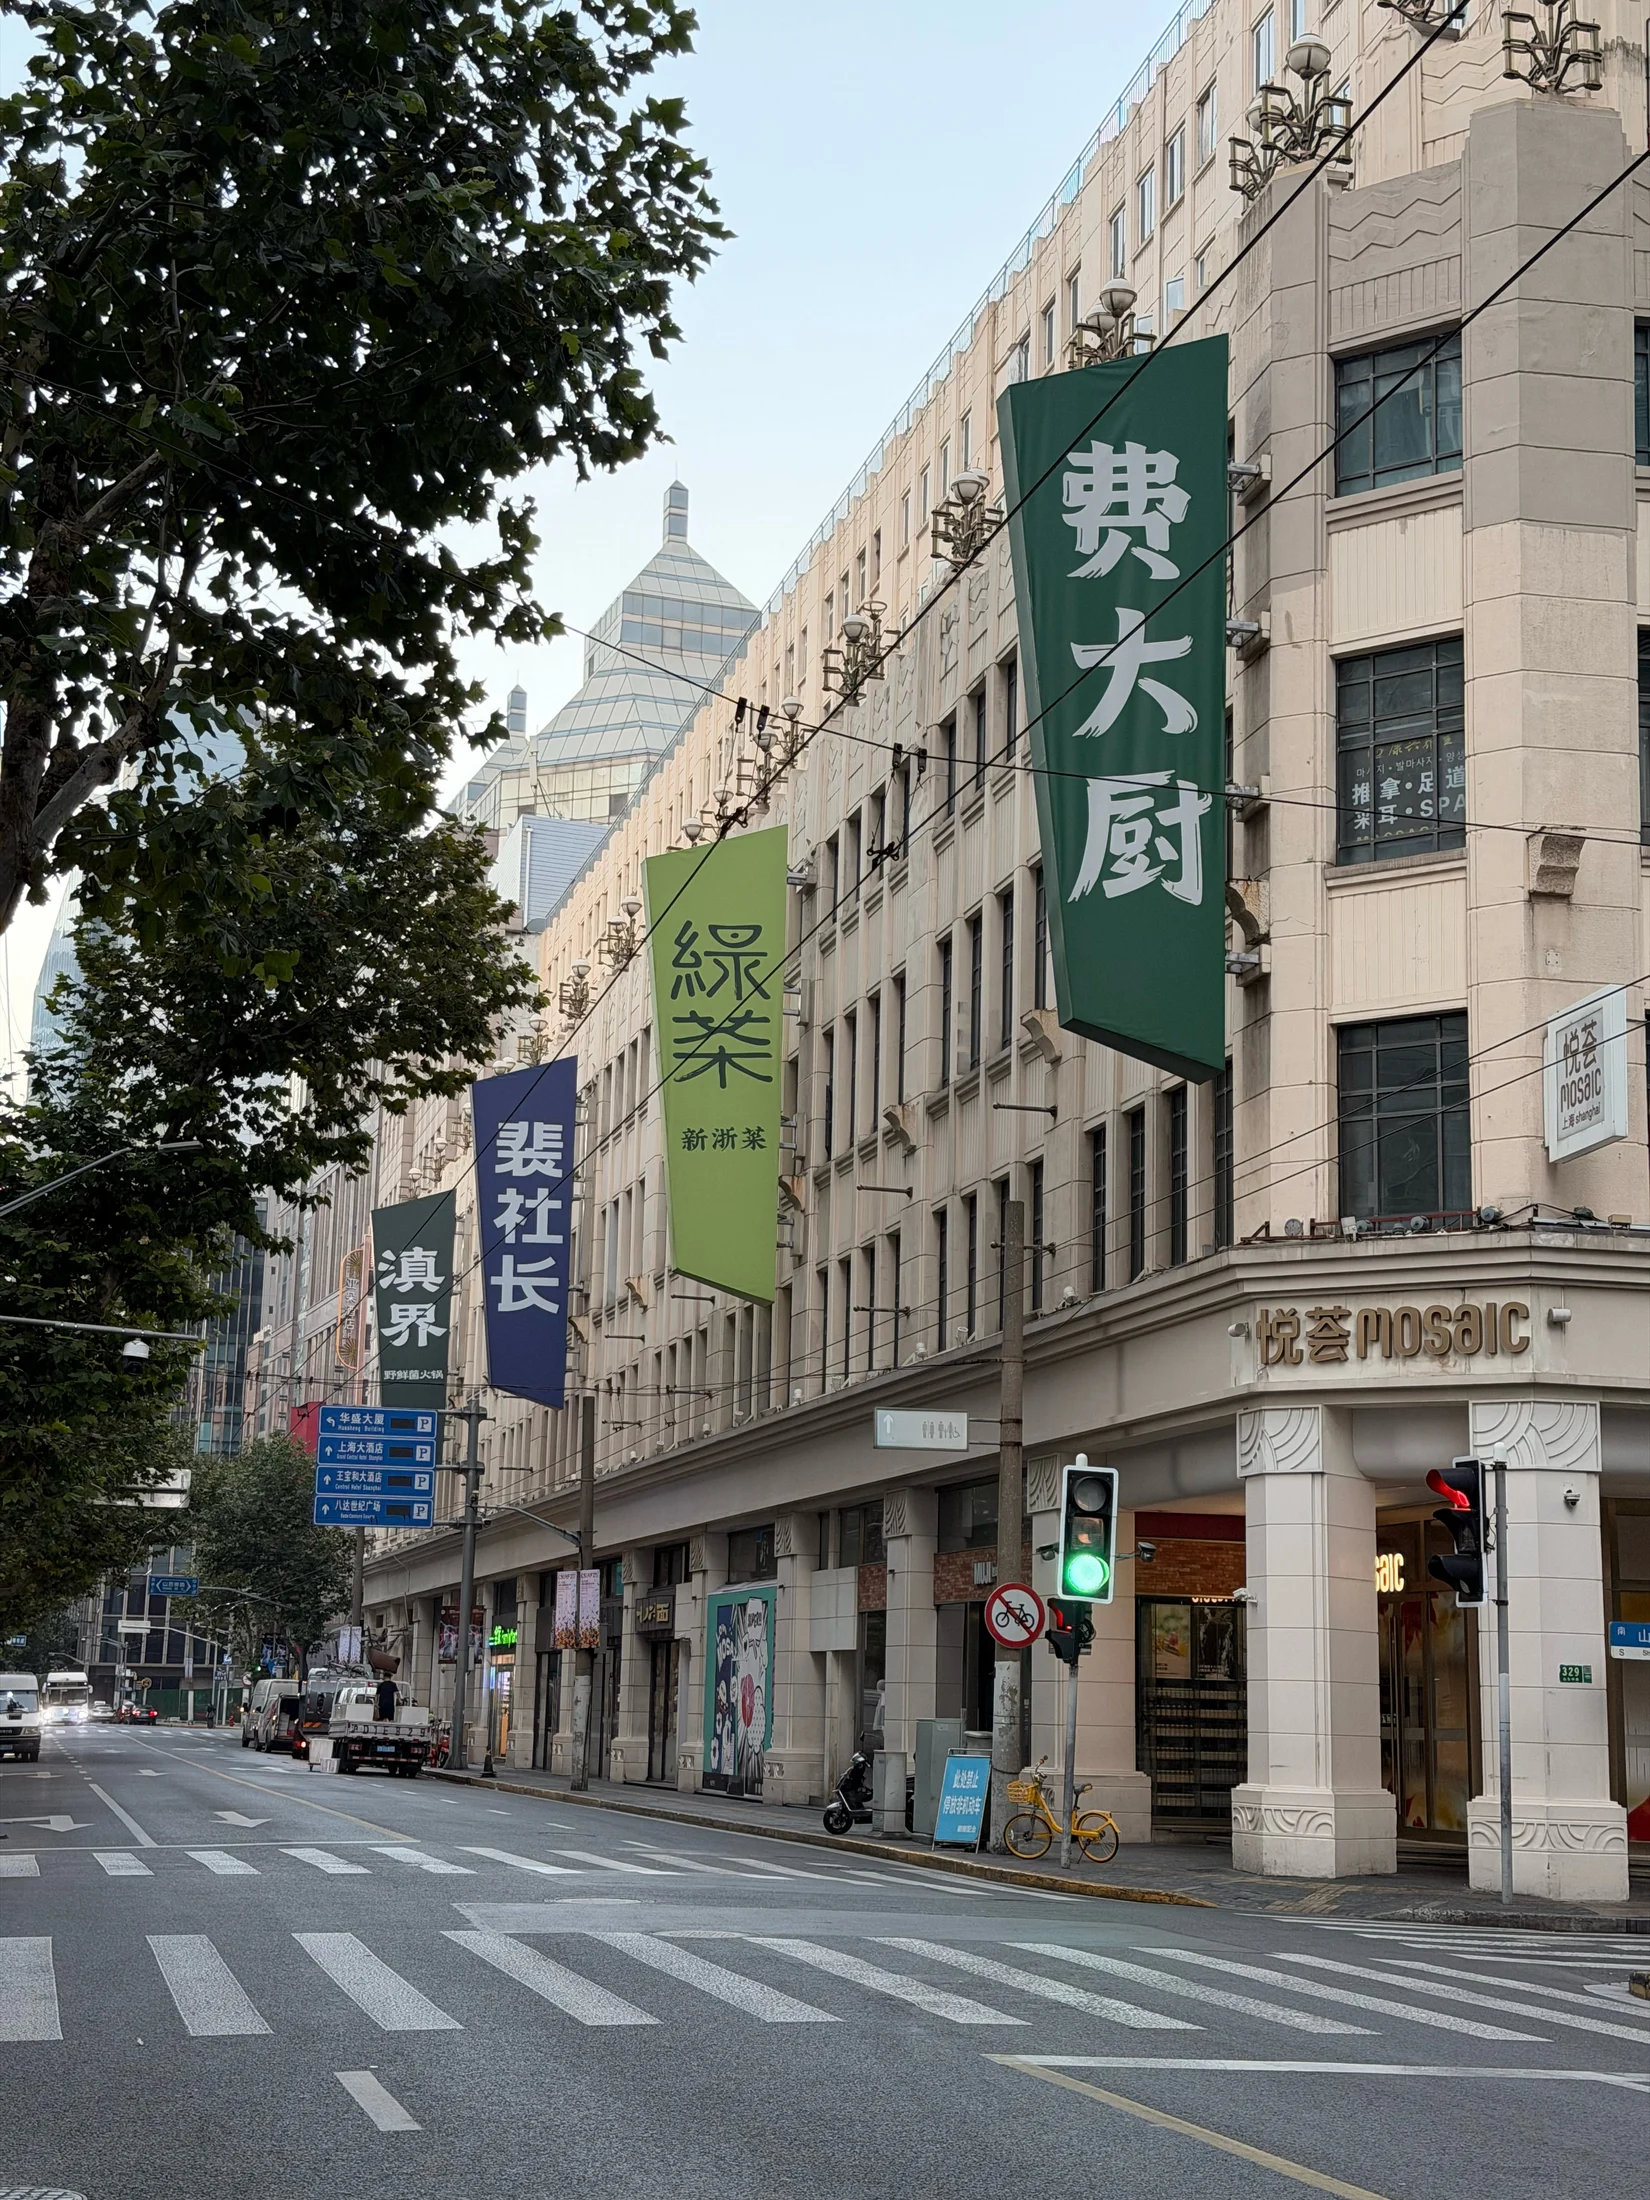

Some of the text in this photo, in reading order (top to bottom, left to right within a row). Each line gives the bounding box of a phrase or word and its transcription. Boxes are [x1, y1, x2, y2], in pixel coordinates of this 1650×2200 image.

[1061, 440, 1212, 906] 费大厨
[1575, 1101, 1601, 1125] shanghai
[681, 1125, 767, 1151] 新浙菜
[490, 1121, 564, 1314] 裴社长
[378, 1247, 447, 1347] 滇界
[1256, 1305, 1352, 1365] 悦荟
[384, 1369, 444, 1380] 野鲜菌火锅
[340, 1412, 429, 1430] 华盛大厦 P
[338, 1441, 428, 1459] 上海大酒店 P
[336, 1470, 426, 1488] 王宝和大酒店 P
[335, 1500, 425, 1517] 八达世纪广场 P
[1619, 1648, 1625, 1656] S
[1562, 1666, 1580, 1677] 329
